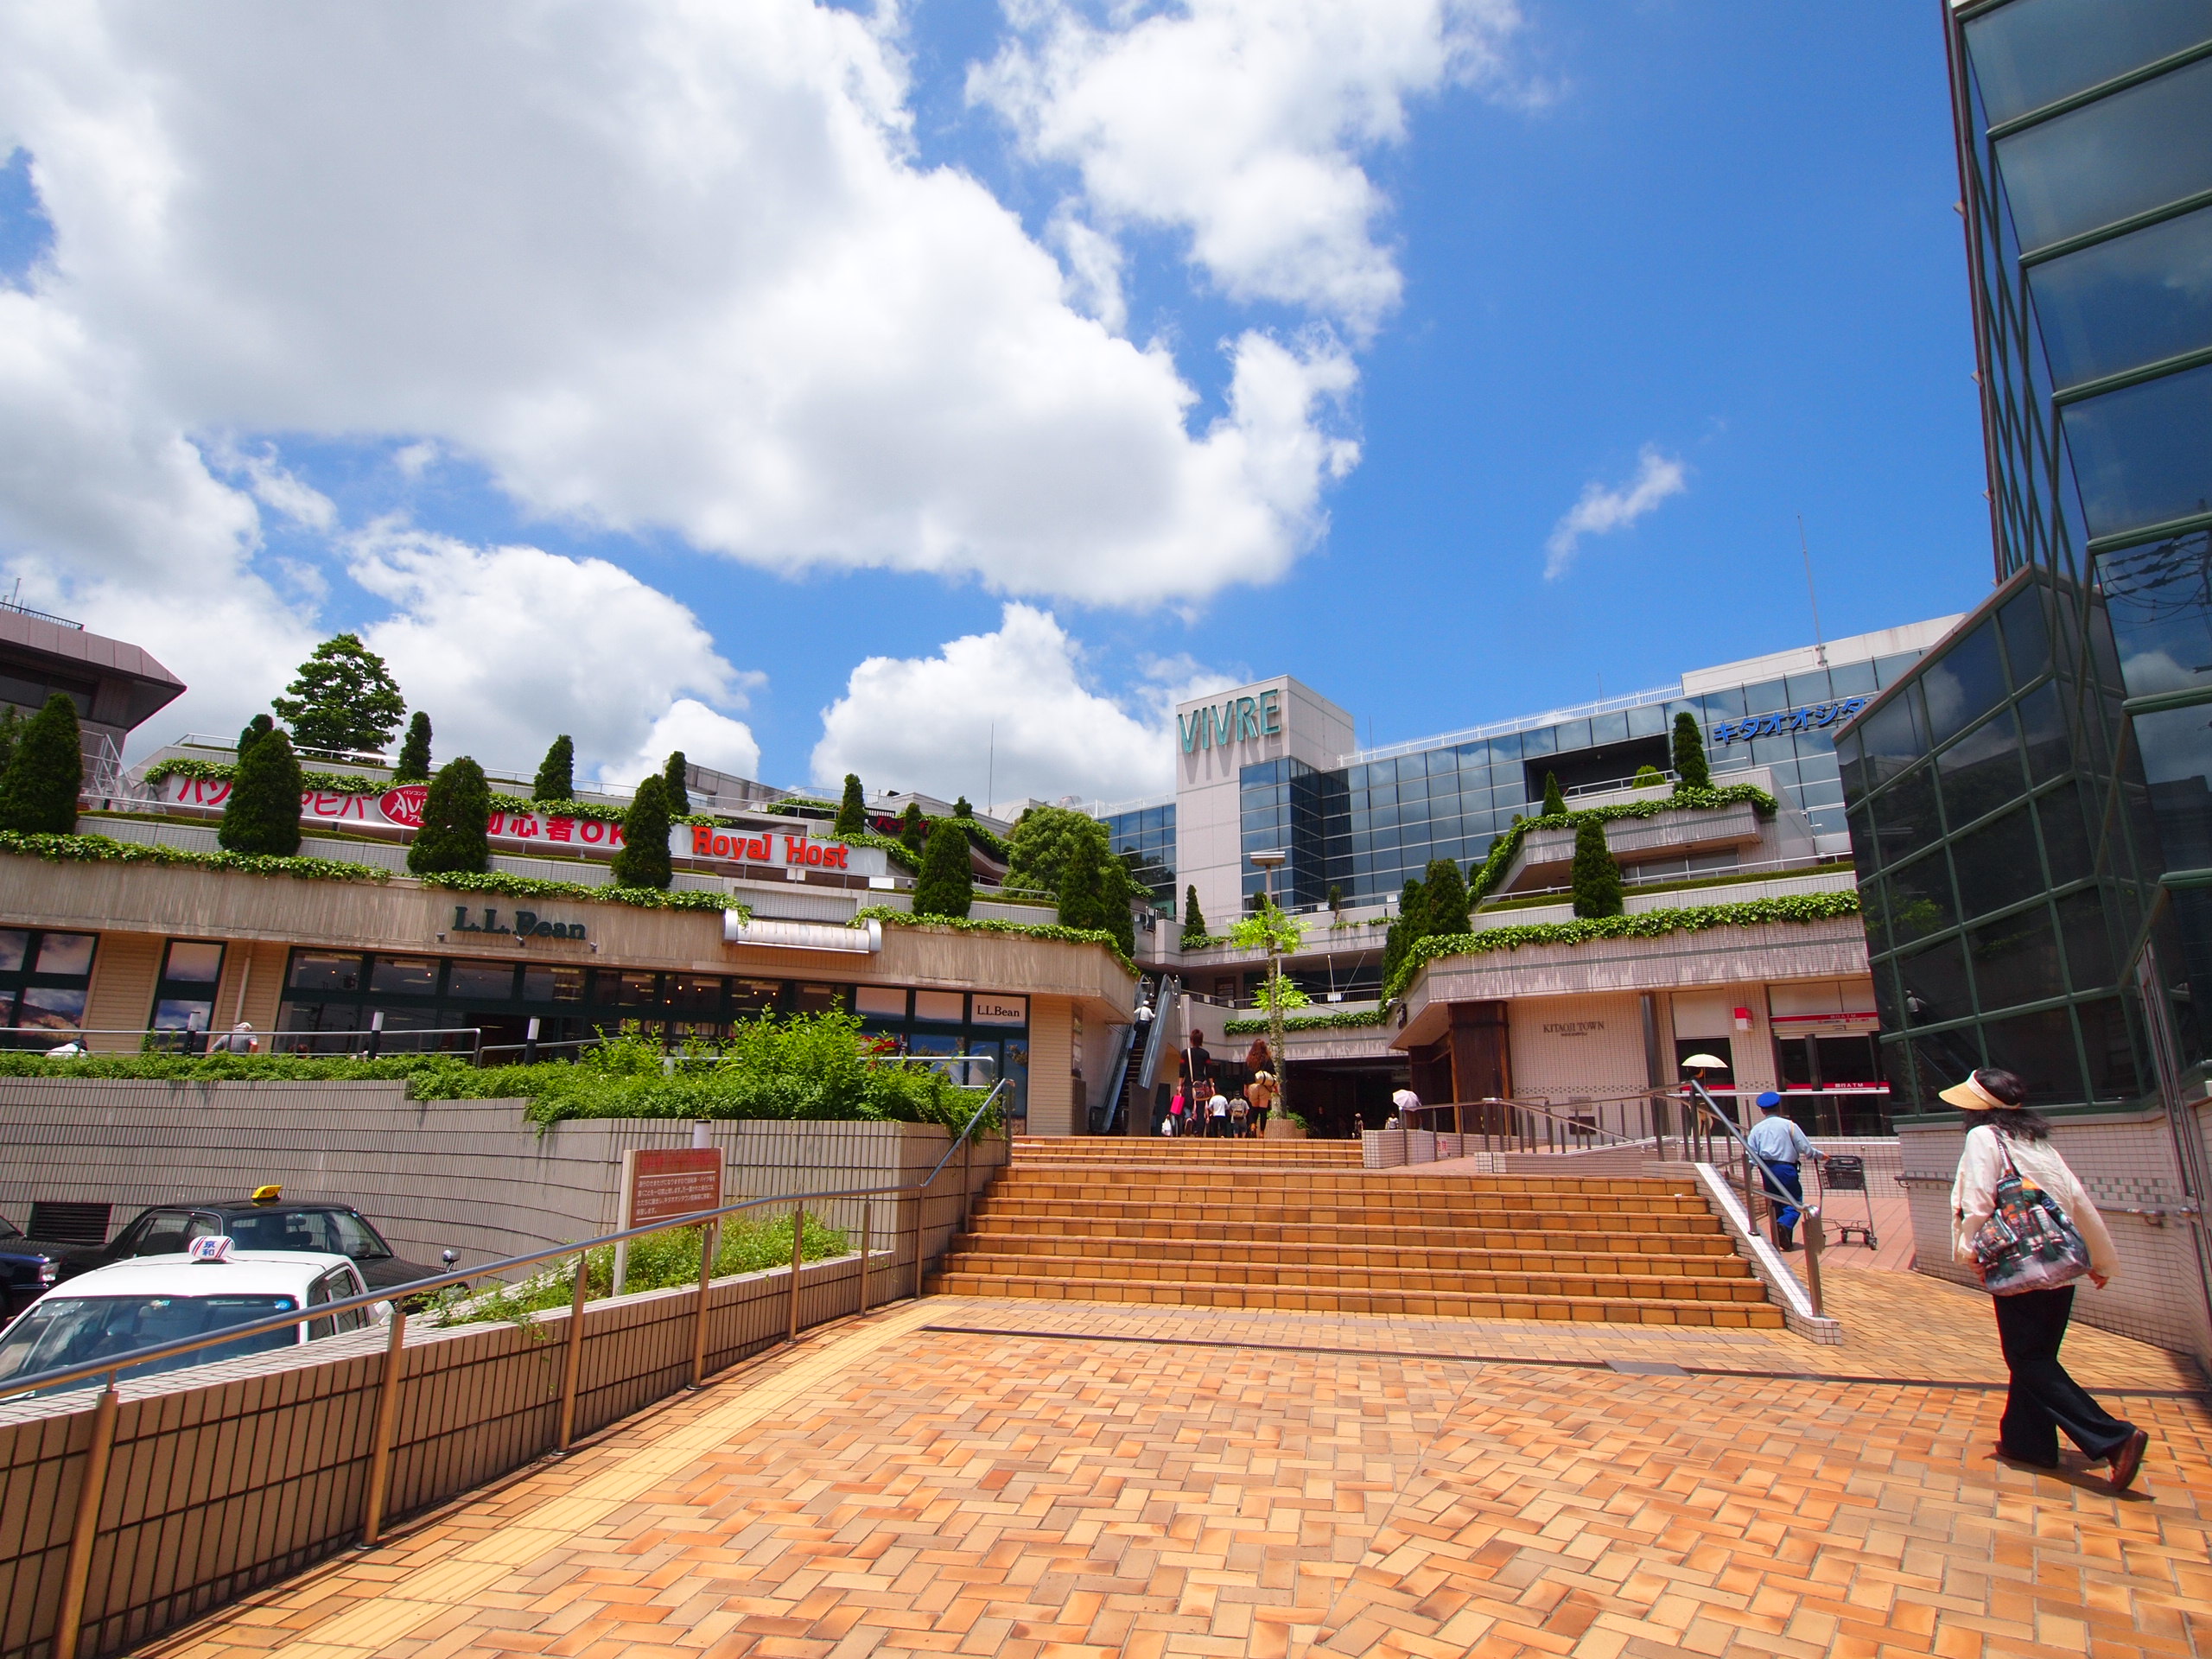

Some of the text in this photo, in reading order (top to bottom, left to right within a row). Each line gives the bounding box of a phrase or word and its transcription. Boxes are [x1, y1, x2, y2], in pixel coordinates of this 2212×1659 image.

[1178, 689, 1281, 753] VIVRE
[692, 826, 849, 868] Royal Host
[1577, 1021, 1605, 1031] TOWN
